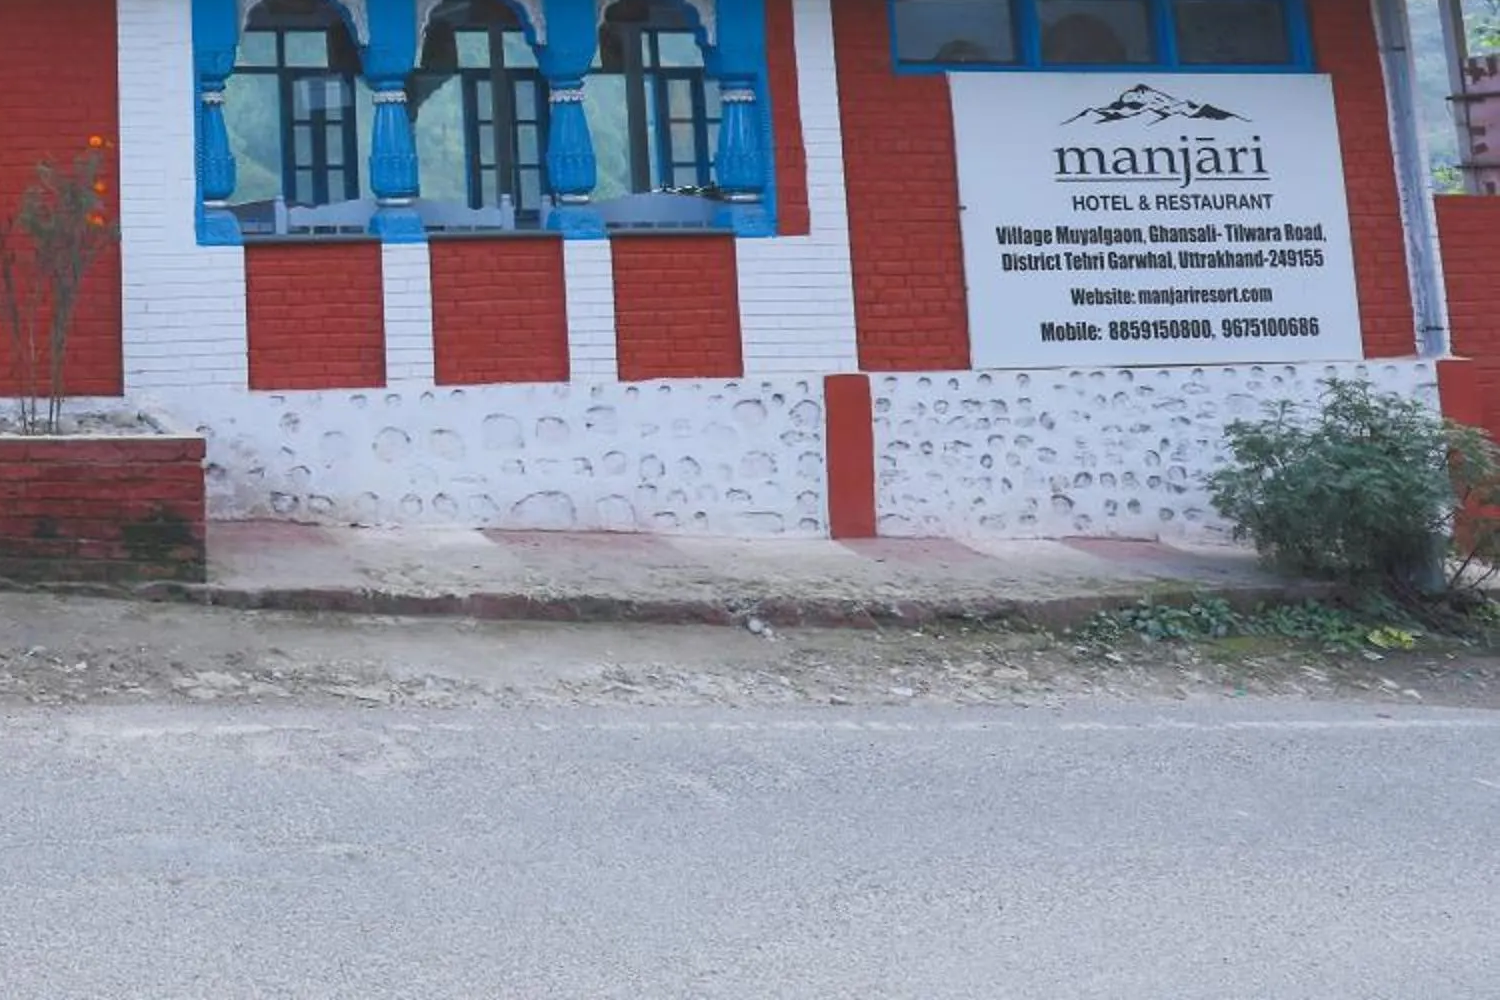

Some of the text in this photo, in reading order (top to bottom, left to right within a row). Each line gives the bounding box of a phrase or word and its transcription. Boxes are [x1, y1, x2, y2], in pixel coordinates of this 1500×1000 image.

[1072, 193, 1274, 211] HOTEL & RESTAURANT
[996, 226, 1053, 247] Village
[1056, 225, 1147, 246] Muyalgaon,
[1224, 223, 1282, 243] Tilwara
[1283, 222, 1327, 242] Road,
[1002, 249, 1324, 272] District Tehri Garwhal, Uttrakhand-249155
[1071, 286, 1273, 306] Website: manjariresort.com
[1041, 316, 1319, 342] Mobile: 8859150800, 9675100686
